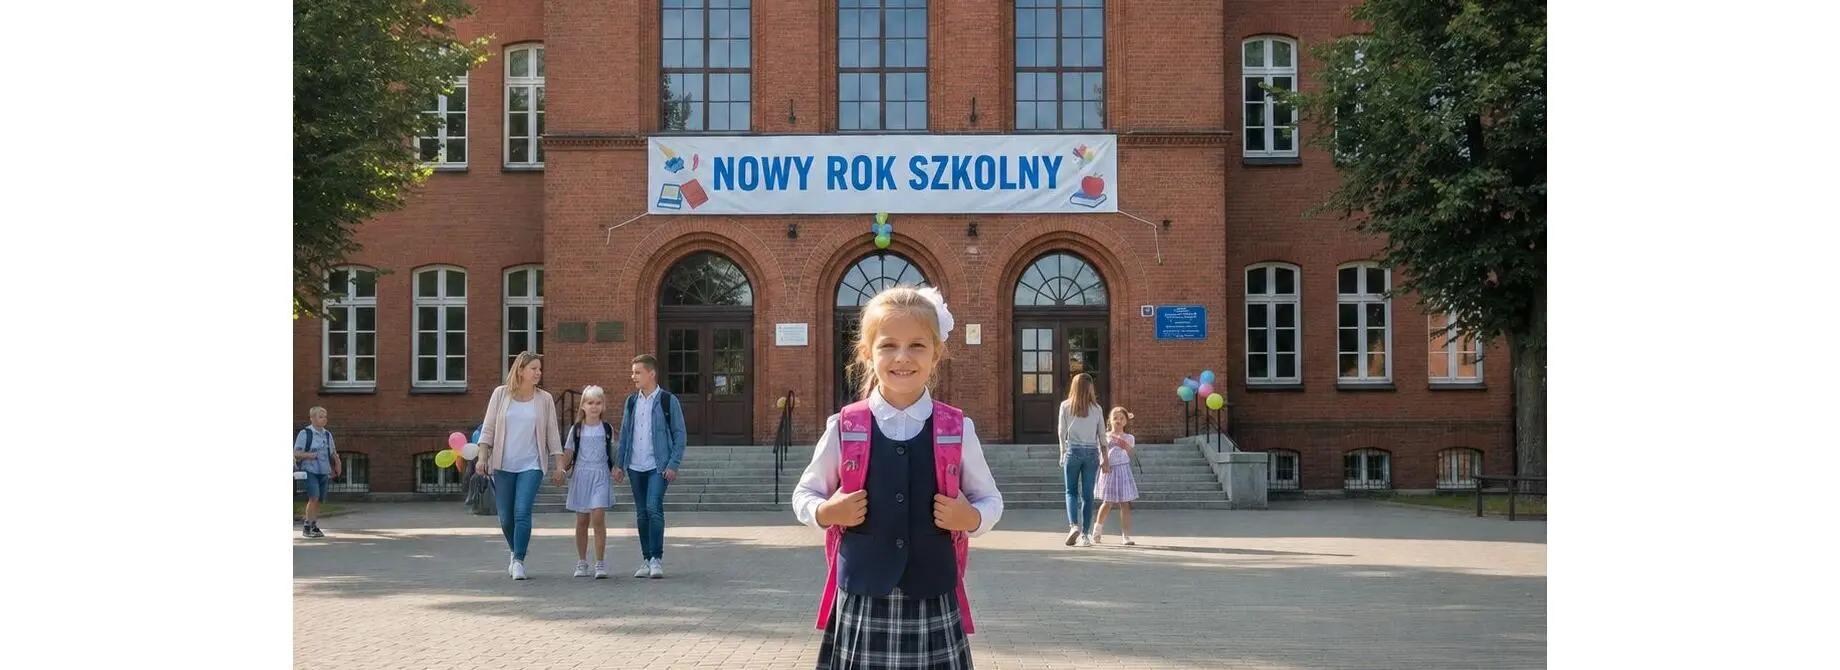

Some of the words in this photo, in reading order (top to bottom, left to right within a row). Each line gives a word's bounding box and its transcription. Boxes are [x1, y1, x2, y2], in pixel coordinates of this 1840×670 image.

[712, 154, 815, 192] NOWY
[826, 154, 898, 191] ROK
[908, 154, 1063, 191] SZKOLNY
